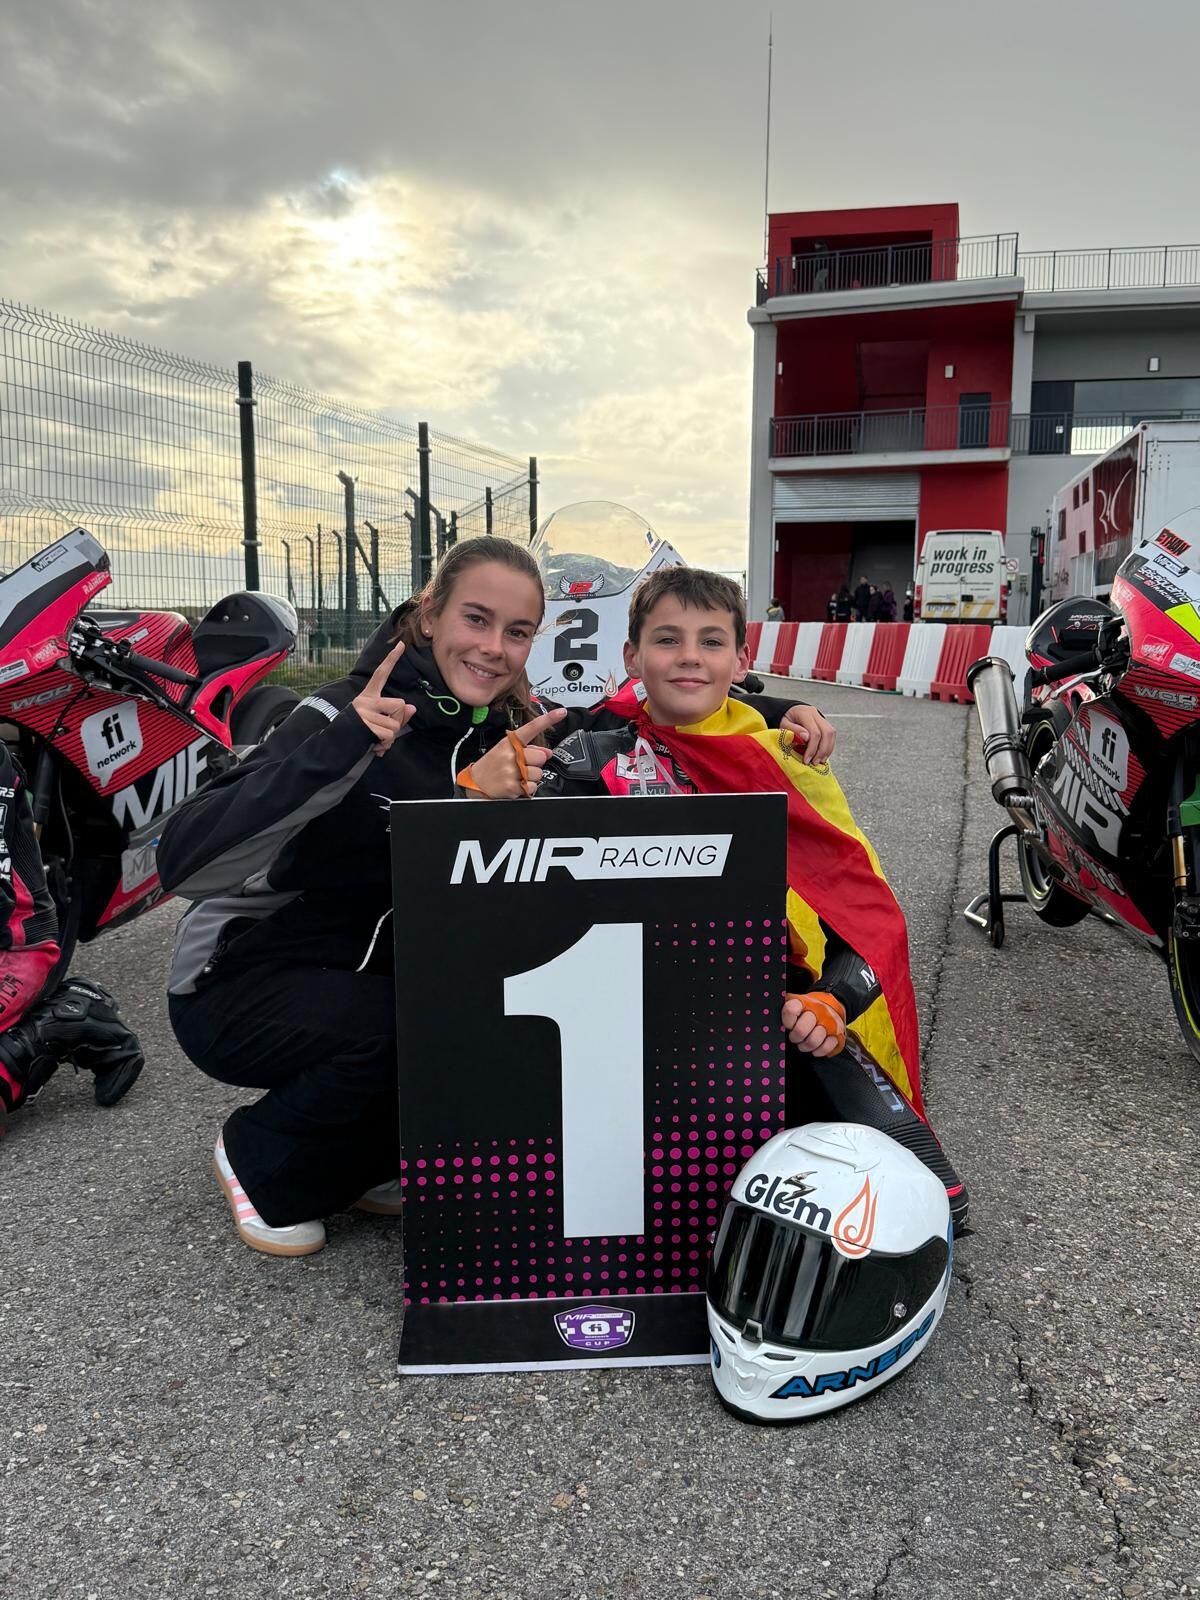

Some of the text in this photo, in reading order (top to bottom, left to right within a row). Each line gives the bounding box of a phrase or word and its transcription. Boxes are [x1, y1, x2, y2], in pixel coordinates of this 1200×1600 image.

[930, 562, 994, 577] progress
[934, 546, 987, 561] work in
[554, 608, 600, 663] 2
[101, 712, 125, 750] fi
[1101, 727, 1117, 763] fi
[97, 740, 137, 769] network
[1092, 753, 1121, 784] network
[450, 837, 718, 884] MIR RACING
[504, 922, 644, 1238] 1
[745, 1174, 832, 1232] Glem
[564, 1313, 593, 1321] MIR
[588, 1323, 602, 1333] fi
[768, 1309, 936, 1399] ARNEDO
